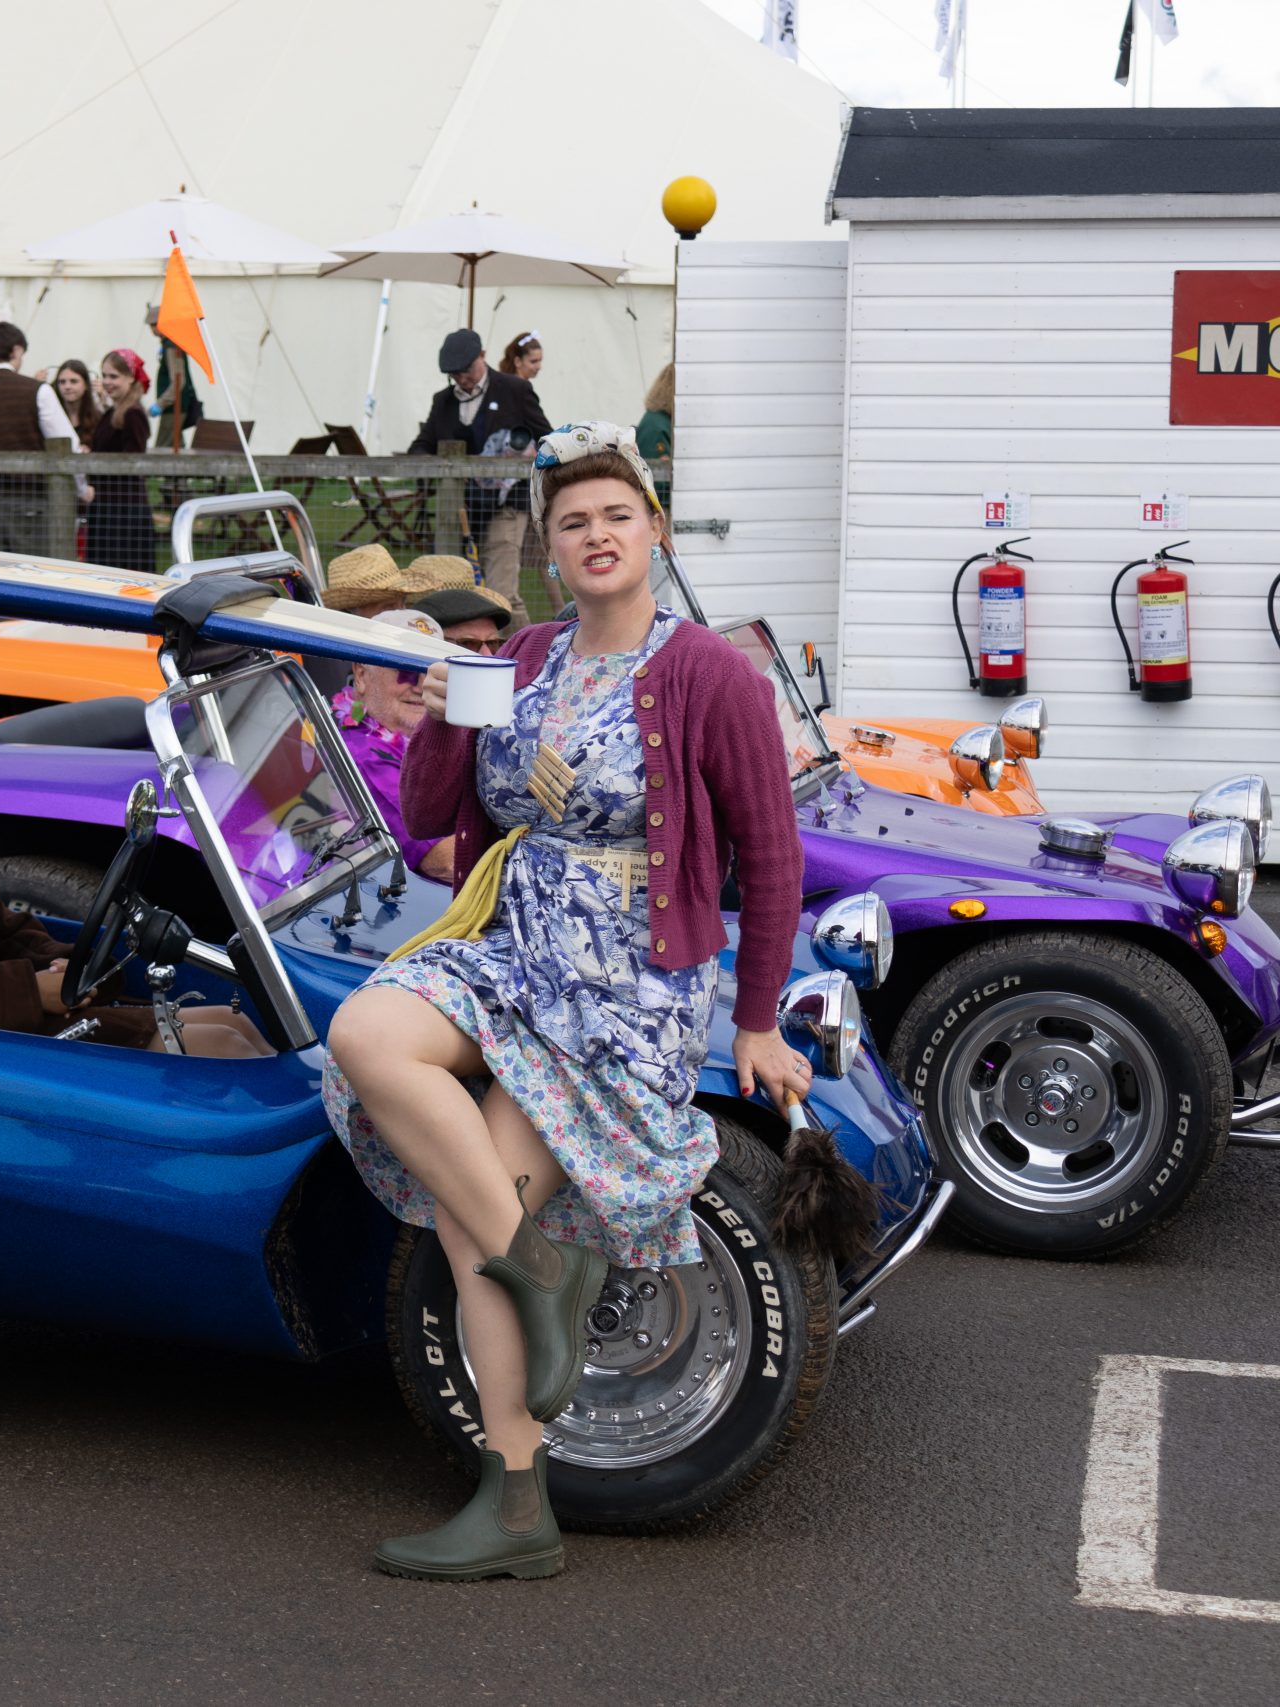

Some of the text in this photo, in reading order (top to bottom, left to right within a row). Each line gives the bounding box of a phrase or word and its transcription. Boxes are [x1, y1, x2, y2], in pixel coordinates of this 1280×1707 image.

[1198, 324, 1280, 374] M
[1148, 1093, 1192, 1197] Radial
[422, 1306, 445, 1366] G/T
[752, 1261, 783, 1378] COBRA
